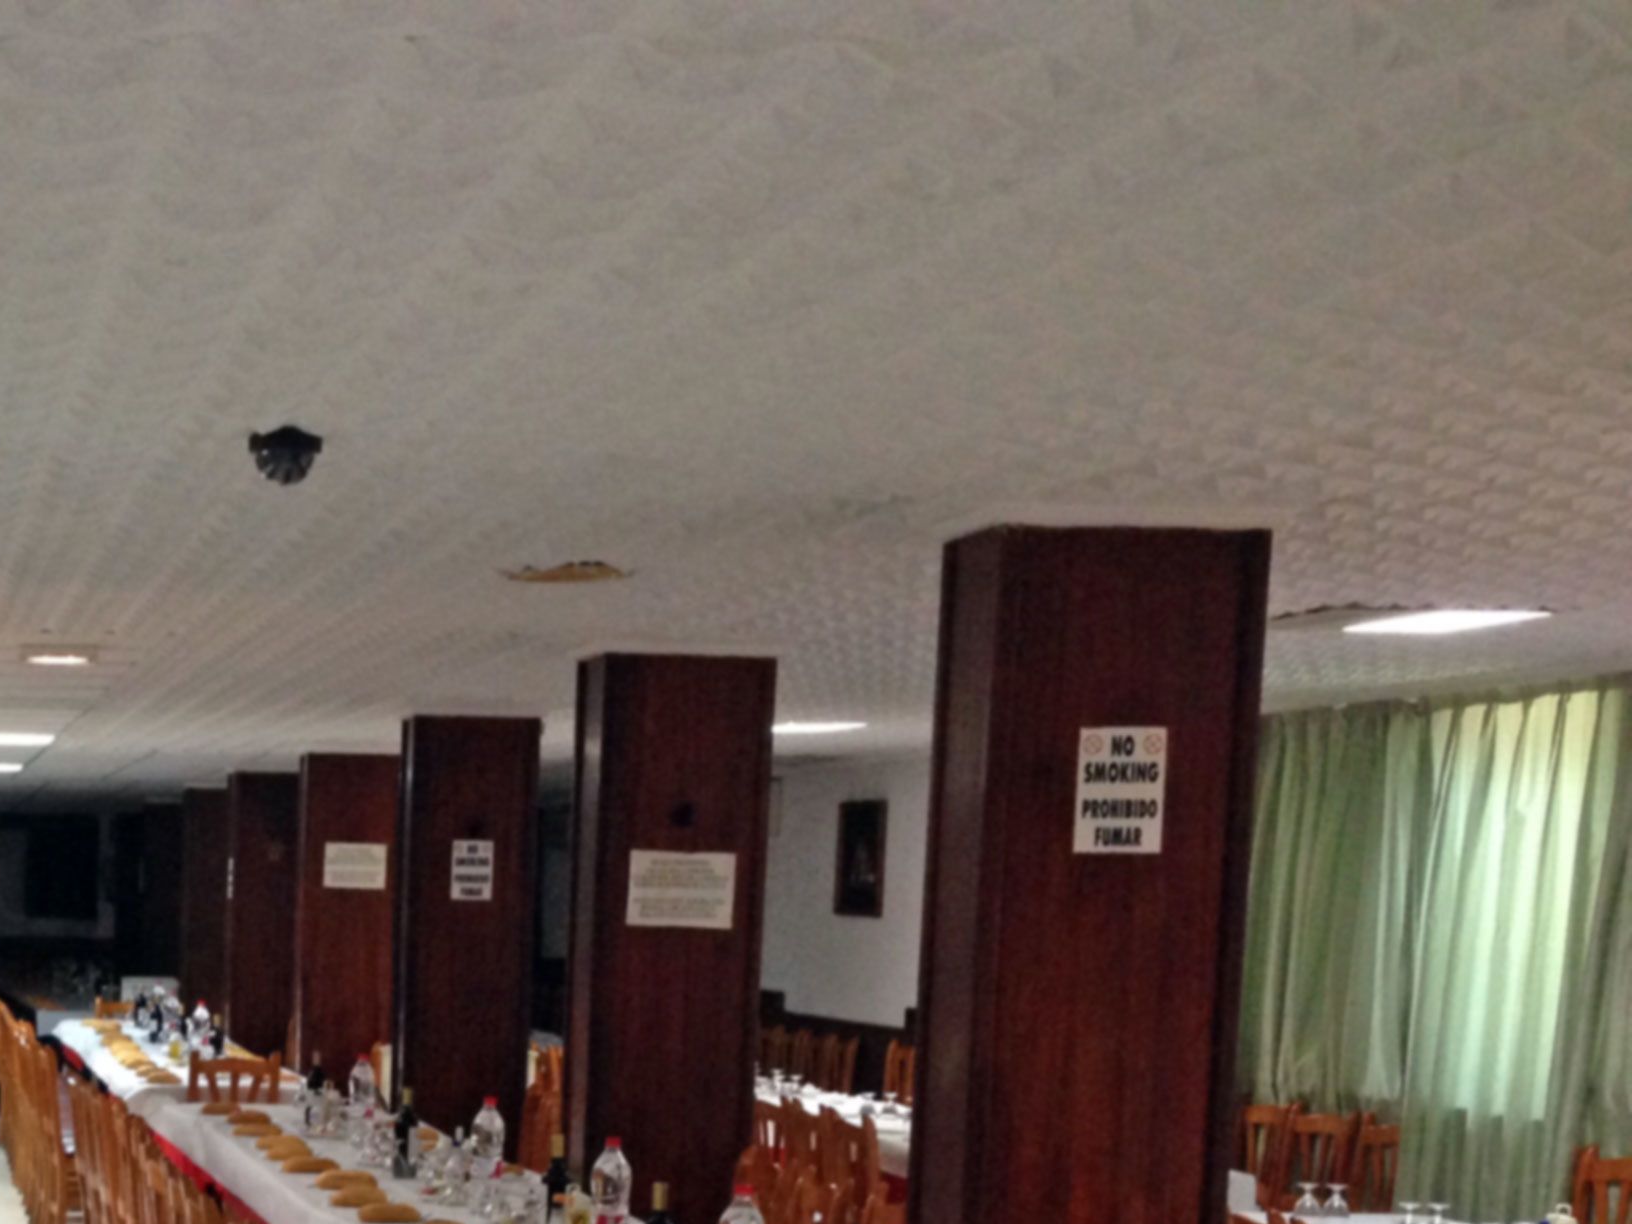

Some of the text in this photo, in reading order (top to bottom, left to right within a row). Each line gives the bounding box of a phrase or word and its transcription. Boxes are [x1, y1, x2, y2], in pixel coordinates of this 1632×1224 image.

[1110, 736, 1135, 756] NO
[1083, 762, 1159, 783] SMOKING
[1081, 799, 1158, 818] PROHIBIDO
[1094, 827, 1142, 846] FUMAR
